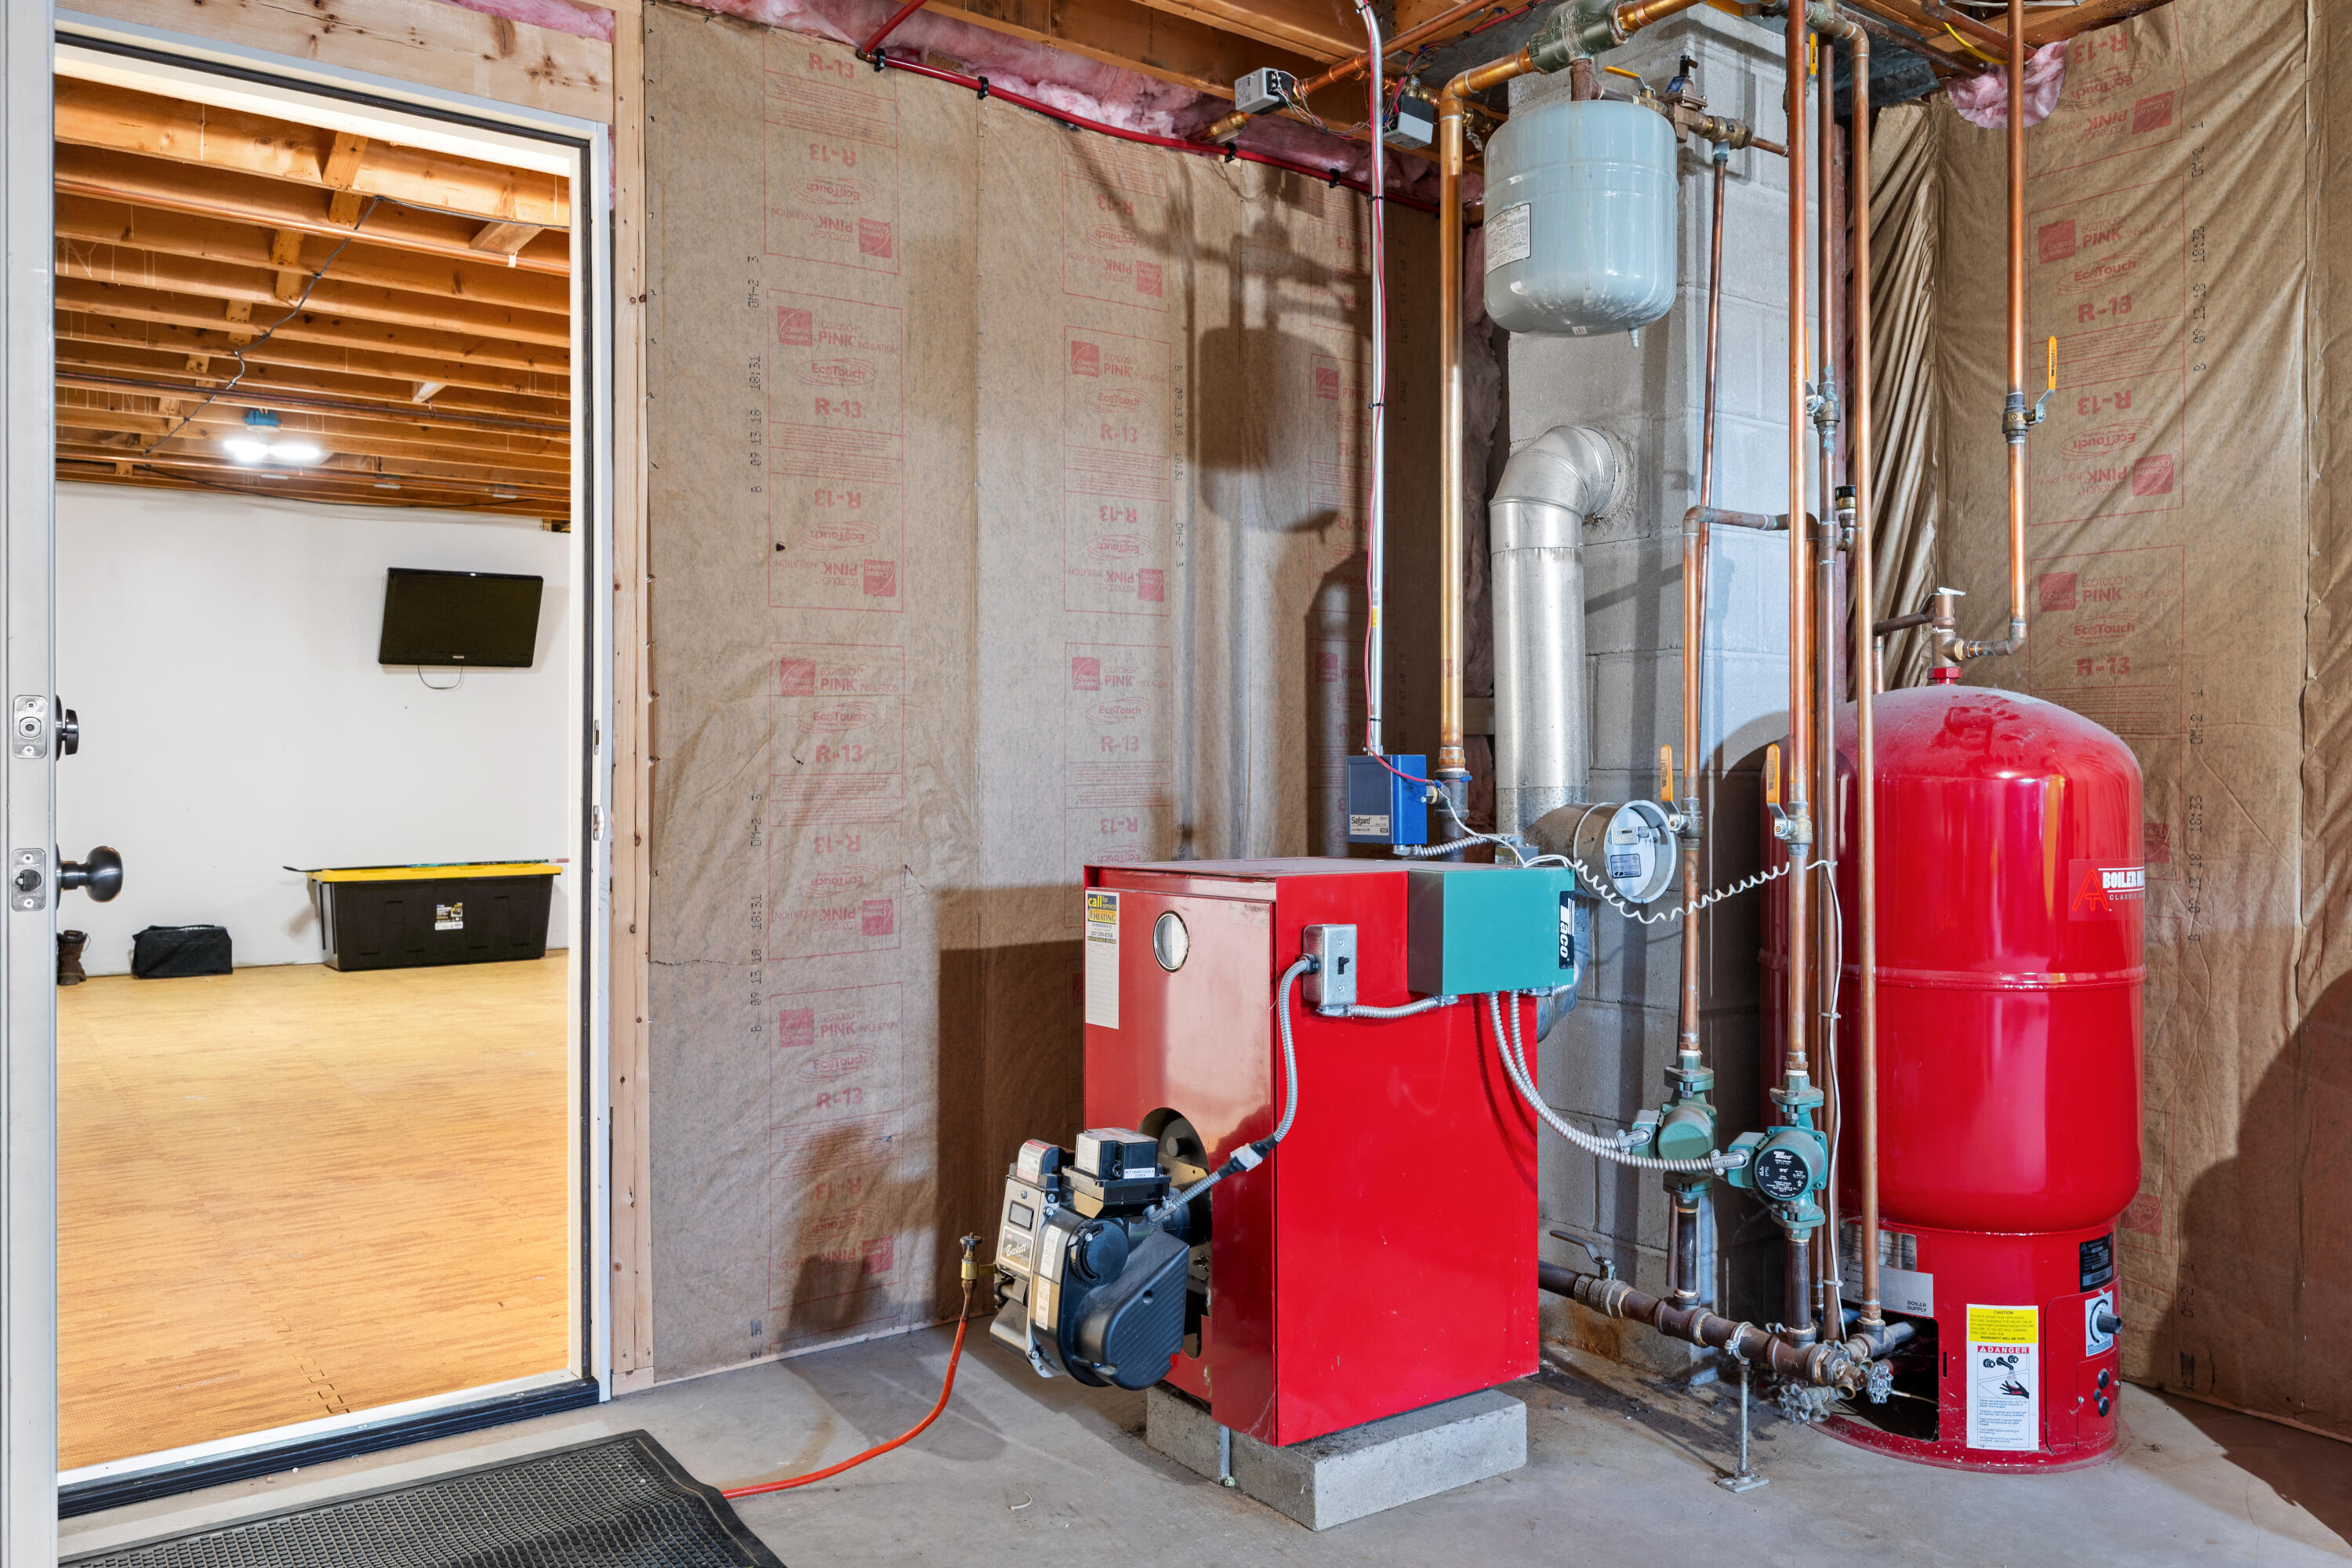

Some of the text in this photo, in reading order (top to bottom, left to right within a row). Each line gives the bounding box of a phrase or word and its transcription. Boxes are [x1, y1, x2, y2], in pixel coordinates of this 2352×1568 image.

[2073, 31, 2128, 64] R-13
[809, 52, 855, 80] R-13
[2086, 110, 2127, 129] PINK
[809, 143, 856, 167] R-13
[2192, 146, 2205, 178] DM-2
[1098, 194, 1134, 217] R-13
[818, 215, 853, 234] PINK
[2083, 226, 2125, 249] PINK
[2192, 226, 2205, 263] 18:33
[1104, 259, 1132, 274] PINK
[2074, 260, 2136, 281] EcoTouch
[2078, 294, 2132, 323] R-13
[818, 330, 855, 347] PINK
[2193, 328, 2205, 343] 09
[747, 256, 762, 494] B 09 13 18 18:31 DM-2 3
[1104, 363, 1133, 378] PINK
[815, 397, 863, 419] R-13
[2078, 390, 2132, 416] R-13
[1100, 423, 1138, 443] R-13
[2074, 433, 2136, 450] EcoTouch
[2085, 466, 2127, 485] PINK
[815, 488, 861, 508] R-13
[1099, 506, 1137, 524] R-13
[823, 561, 858, 576] PINK
[1106, 571, 1134, 584] PINK
[2082, 586, 2123, 603] PINK
[2074, 622, 2136, 636] EcoTouch
[2077, 656, 2131, 677] R-13
[820, 677, 858, 691] PINK
[1105, 675, 1134, 688] PINK
[2190, 714, 2203, 745] DM-2
[1101, 735, 1138, 752] R-13
[816, 744, 863, 763] R-13
[1351, 817, 1371, 826] Safgard
[2190, 796, 2202, 833] 18:33
[751, 818, 761, 847] DM-2
[1100, 817, 1138, 833] R-13
[814, 834, 862, 854] R-13
[2190, 854, 2202, 869] 18
[1087, 895, 1102, 908] call
[751, 895, 761, 930] 18:31
[820, 907, 855, 921] PINK
[1094, 913, 1116, 923] HEATING
[1560, 898, 1575, 958] Taco
[751, 949, 761, 964] 18
[750, 970, 761, 985] 13
[750, 992, 761, 1006] 09
[820, 1022, 855, 1037] PINK
[816, 1087, 862, 1110] R-13
[815, 1177, 862, 1201] R-13
[1006, 1242, 1027, 1257] Beckett
[2181, 1289, 2194, 1318] DM-2
